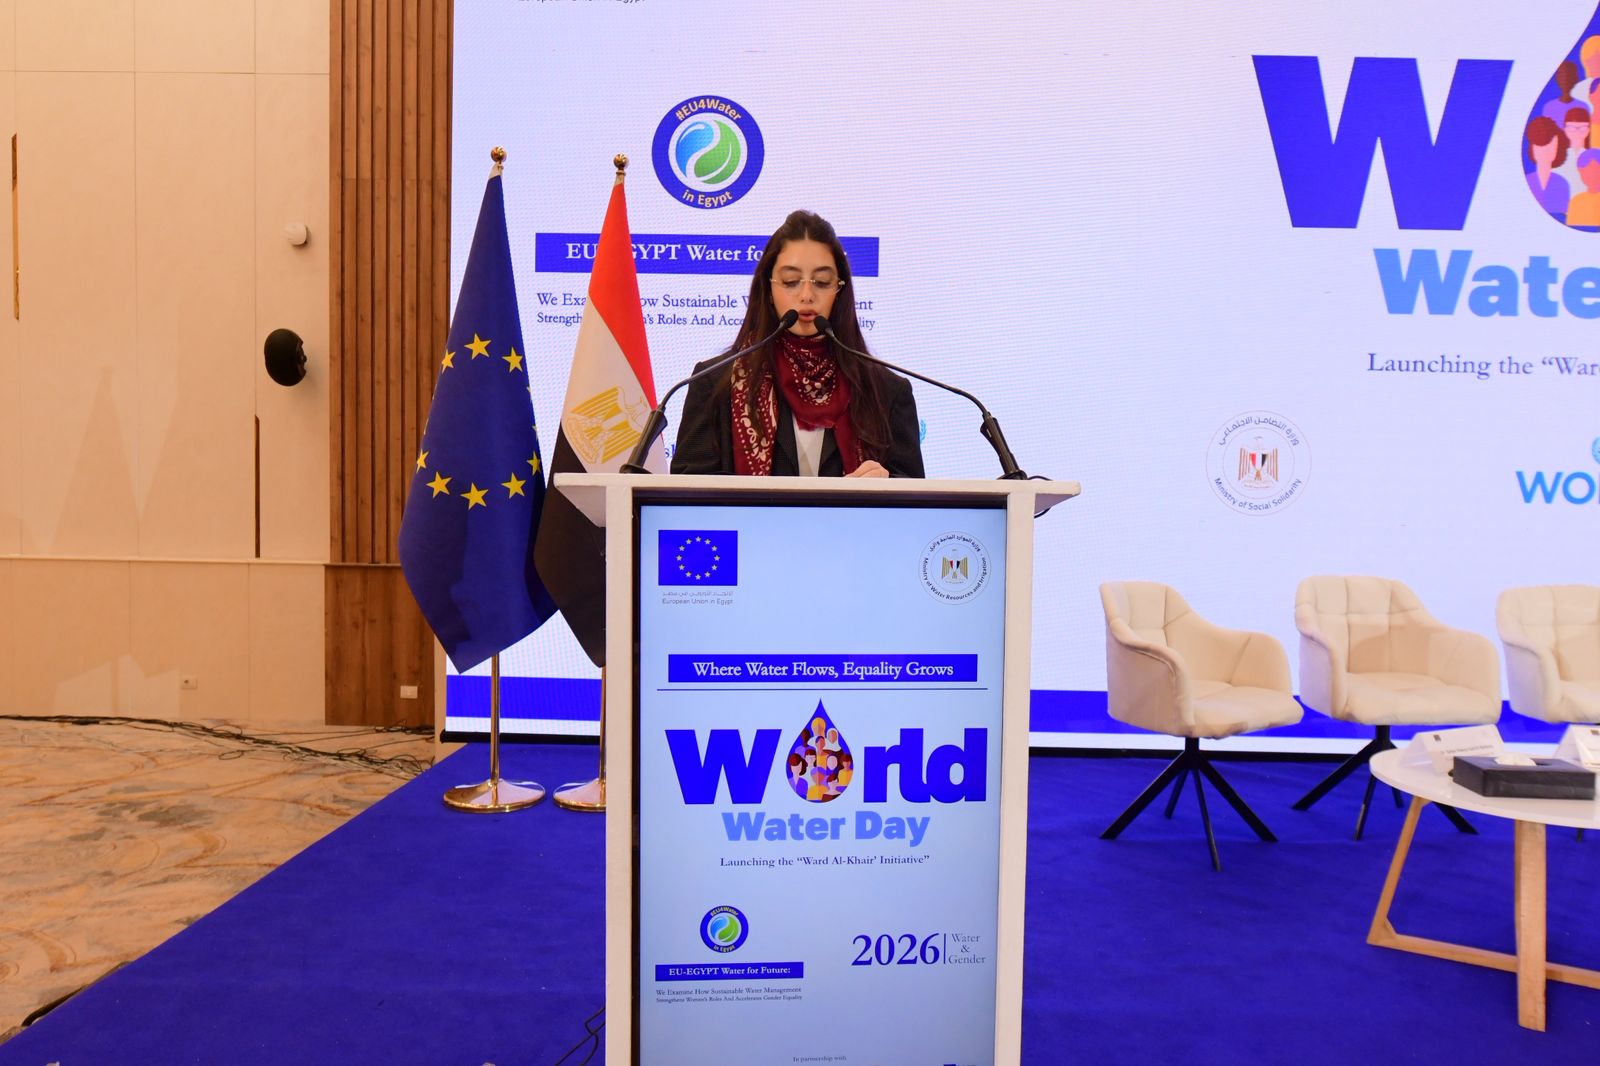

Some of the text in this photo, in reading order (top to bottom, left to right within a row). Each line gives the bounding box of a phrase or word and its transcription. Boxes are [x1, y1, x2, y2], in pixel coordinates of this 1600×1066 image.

[675, 98, 742, 121] #EU4Water
[682, 189, 733, 208] in Egypt
[686, 244, 743, 261] Water
[750, 245, 762, 261] fo
[1373, 248, 1600, 320] Wate
[537, 293, 558, 306] We
[641, 297, 659, 308] ow
[662, 294, 738, 308] Sustainable
[657, 314, 688, 325] Roles
[690, 315, 717, 326] And
[1367, 353, 1600, 380] Launching the “War
[1214, 477, 1237, 505] Ministry
[1248, 502, 1272, 511] Social
[1272, 478, 1302, 506] Solidarity
[930, 585, 945, 598] Water
[945, 591, 973, 600] Resources
[693, 661, 954, 680] Where Water Flows, Equality Grows
[721, 811, 931, 847] Water Day
[720, 857, 775, 868] Launching
[778, 857, 794, 866] the
[797, 856, 829, 866] “Ward
[880, 855, 930, 865] Initiative”
[951, 933, 981, 943] Water
[851, 933, 940, 966] 2026
[960, 944, 970, 953] &
[948, 954, 986, 964] Gender
[669, 966, 791, 976] EU-EGYPT Water for Future:
[667, 988, 693, 996] Examine
[711, 987, 743, 995] Sustainable
[764, 986, 802, 995] Management
